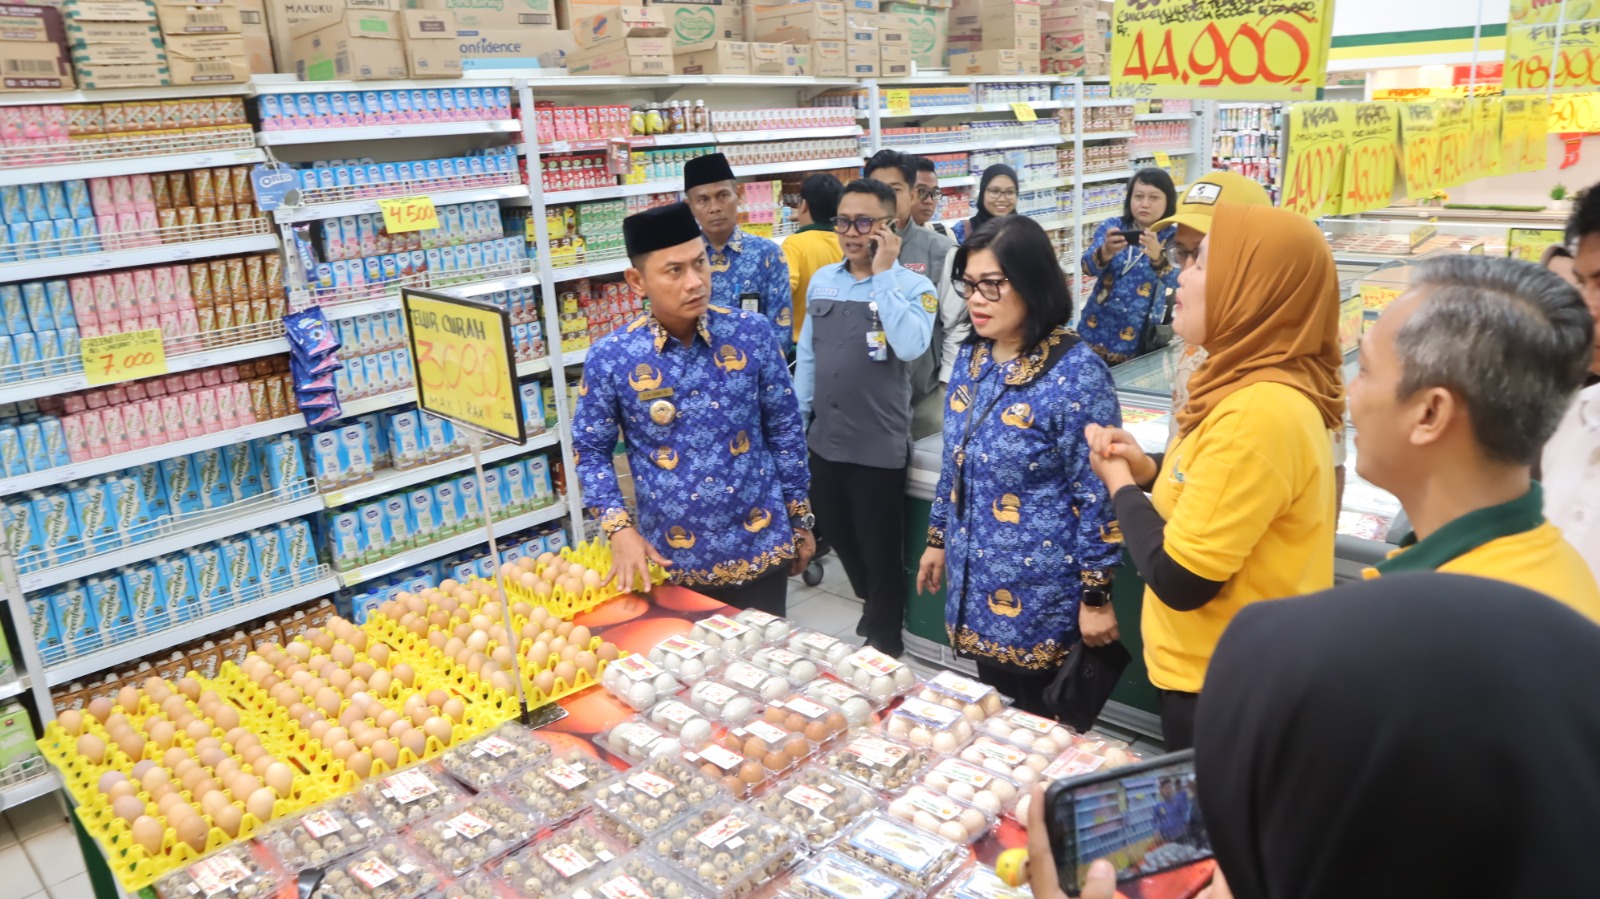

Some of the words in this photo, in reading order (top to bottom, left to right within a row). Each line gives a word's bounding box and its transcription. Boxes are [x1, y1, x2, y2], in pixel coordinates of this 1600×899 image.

[285, 5, 333, 13] MAKUKU
[459, 38, 520, 54] onfidence
[50, 500, 65, 548] Greenfields
[86, 492, 103, 538] Greenfields
[121, 482, 136, 528] Greenfields
[234, 545, 247, 588] Greenfields
[265, 536, 277, 578] Greenfields
[293, 527, 305, 569] Greenfields
[138, 573, 152, 619] Greenfields
[170, 564, 185, 608] Greenfields
[203, 554, 217, 598] Greenfields
[68, 594, 83, 640] Greenfields
[103, 583, 118, 629] Greenfields
